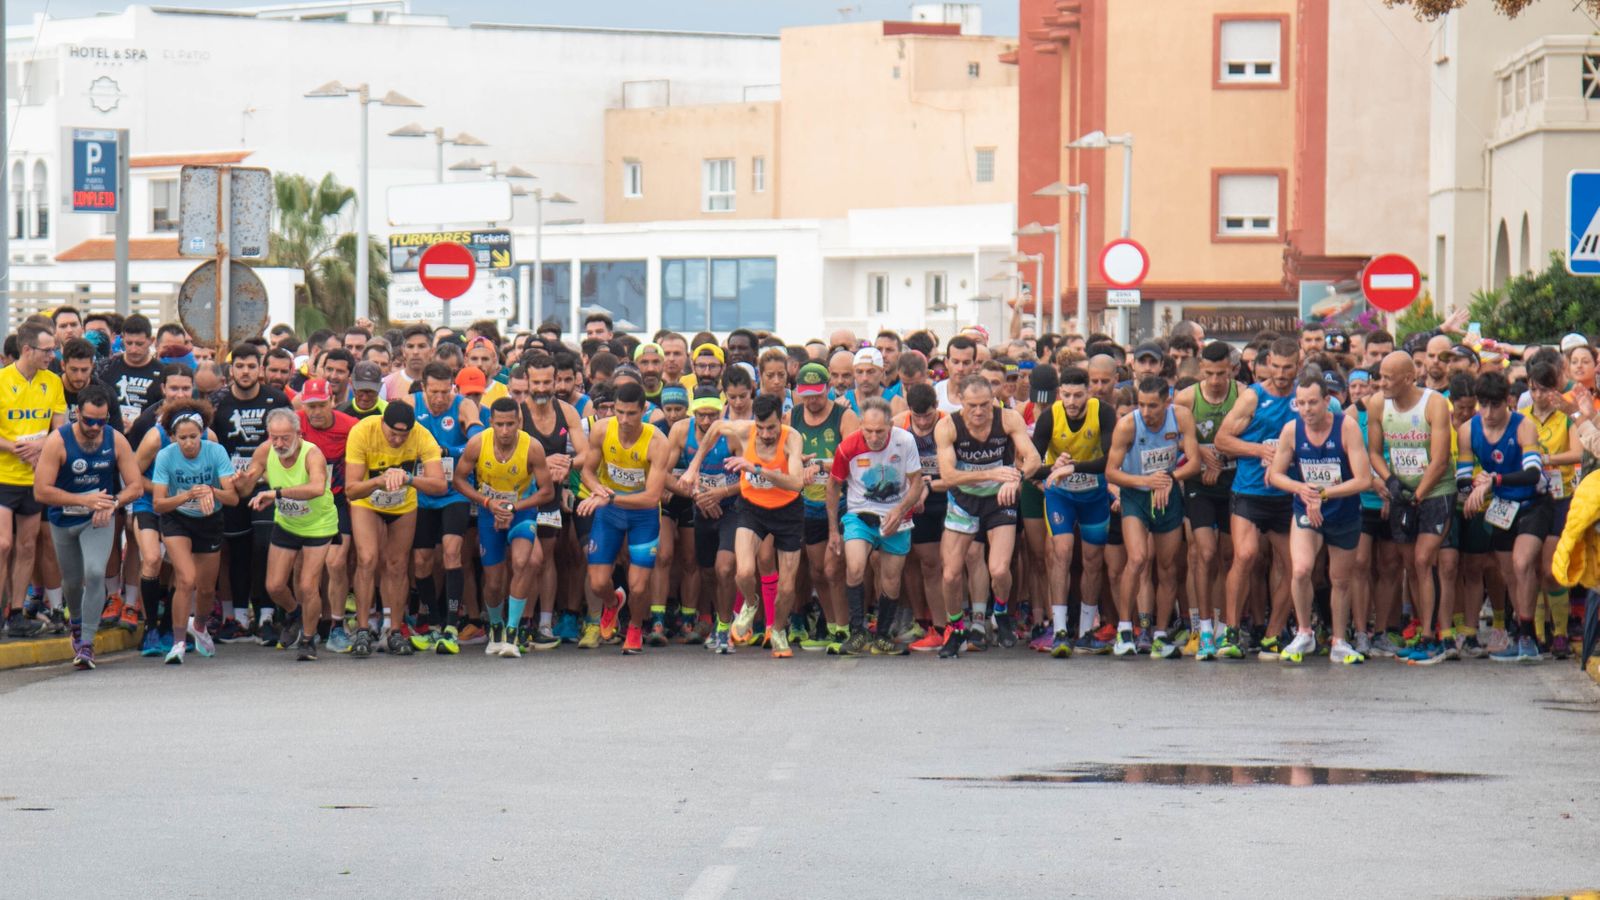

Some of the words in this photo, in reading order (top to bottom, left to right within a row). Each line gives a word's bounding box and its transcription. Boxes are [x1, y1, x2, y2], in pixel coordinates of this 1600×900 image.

[69, 46, 109, 58] HOTEL
[113, 49, 121, 59] &
[125, 48, 149, 60] SPA
[86, 141, 102, 175] P
[73, 190, 116, 208] COMPLETO
[390, 231, 472, 246] TURMARES
[472, 233, 510, 243] Tickets
[241, 408, 266, 418] XIV
